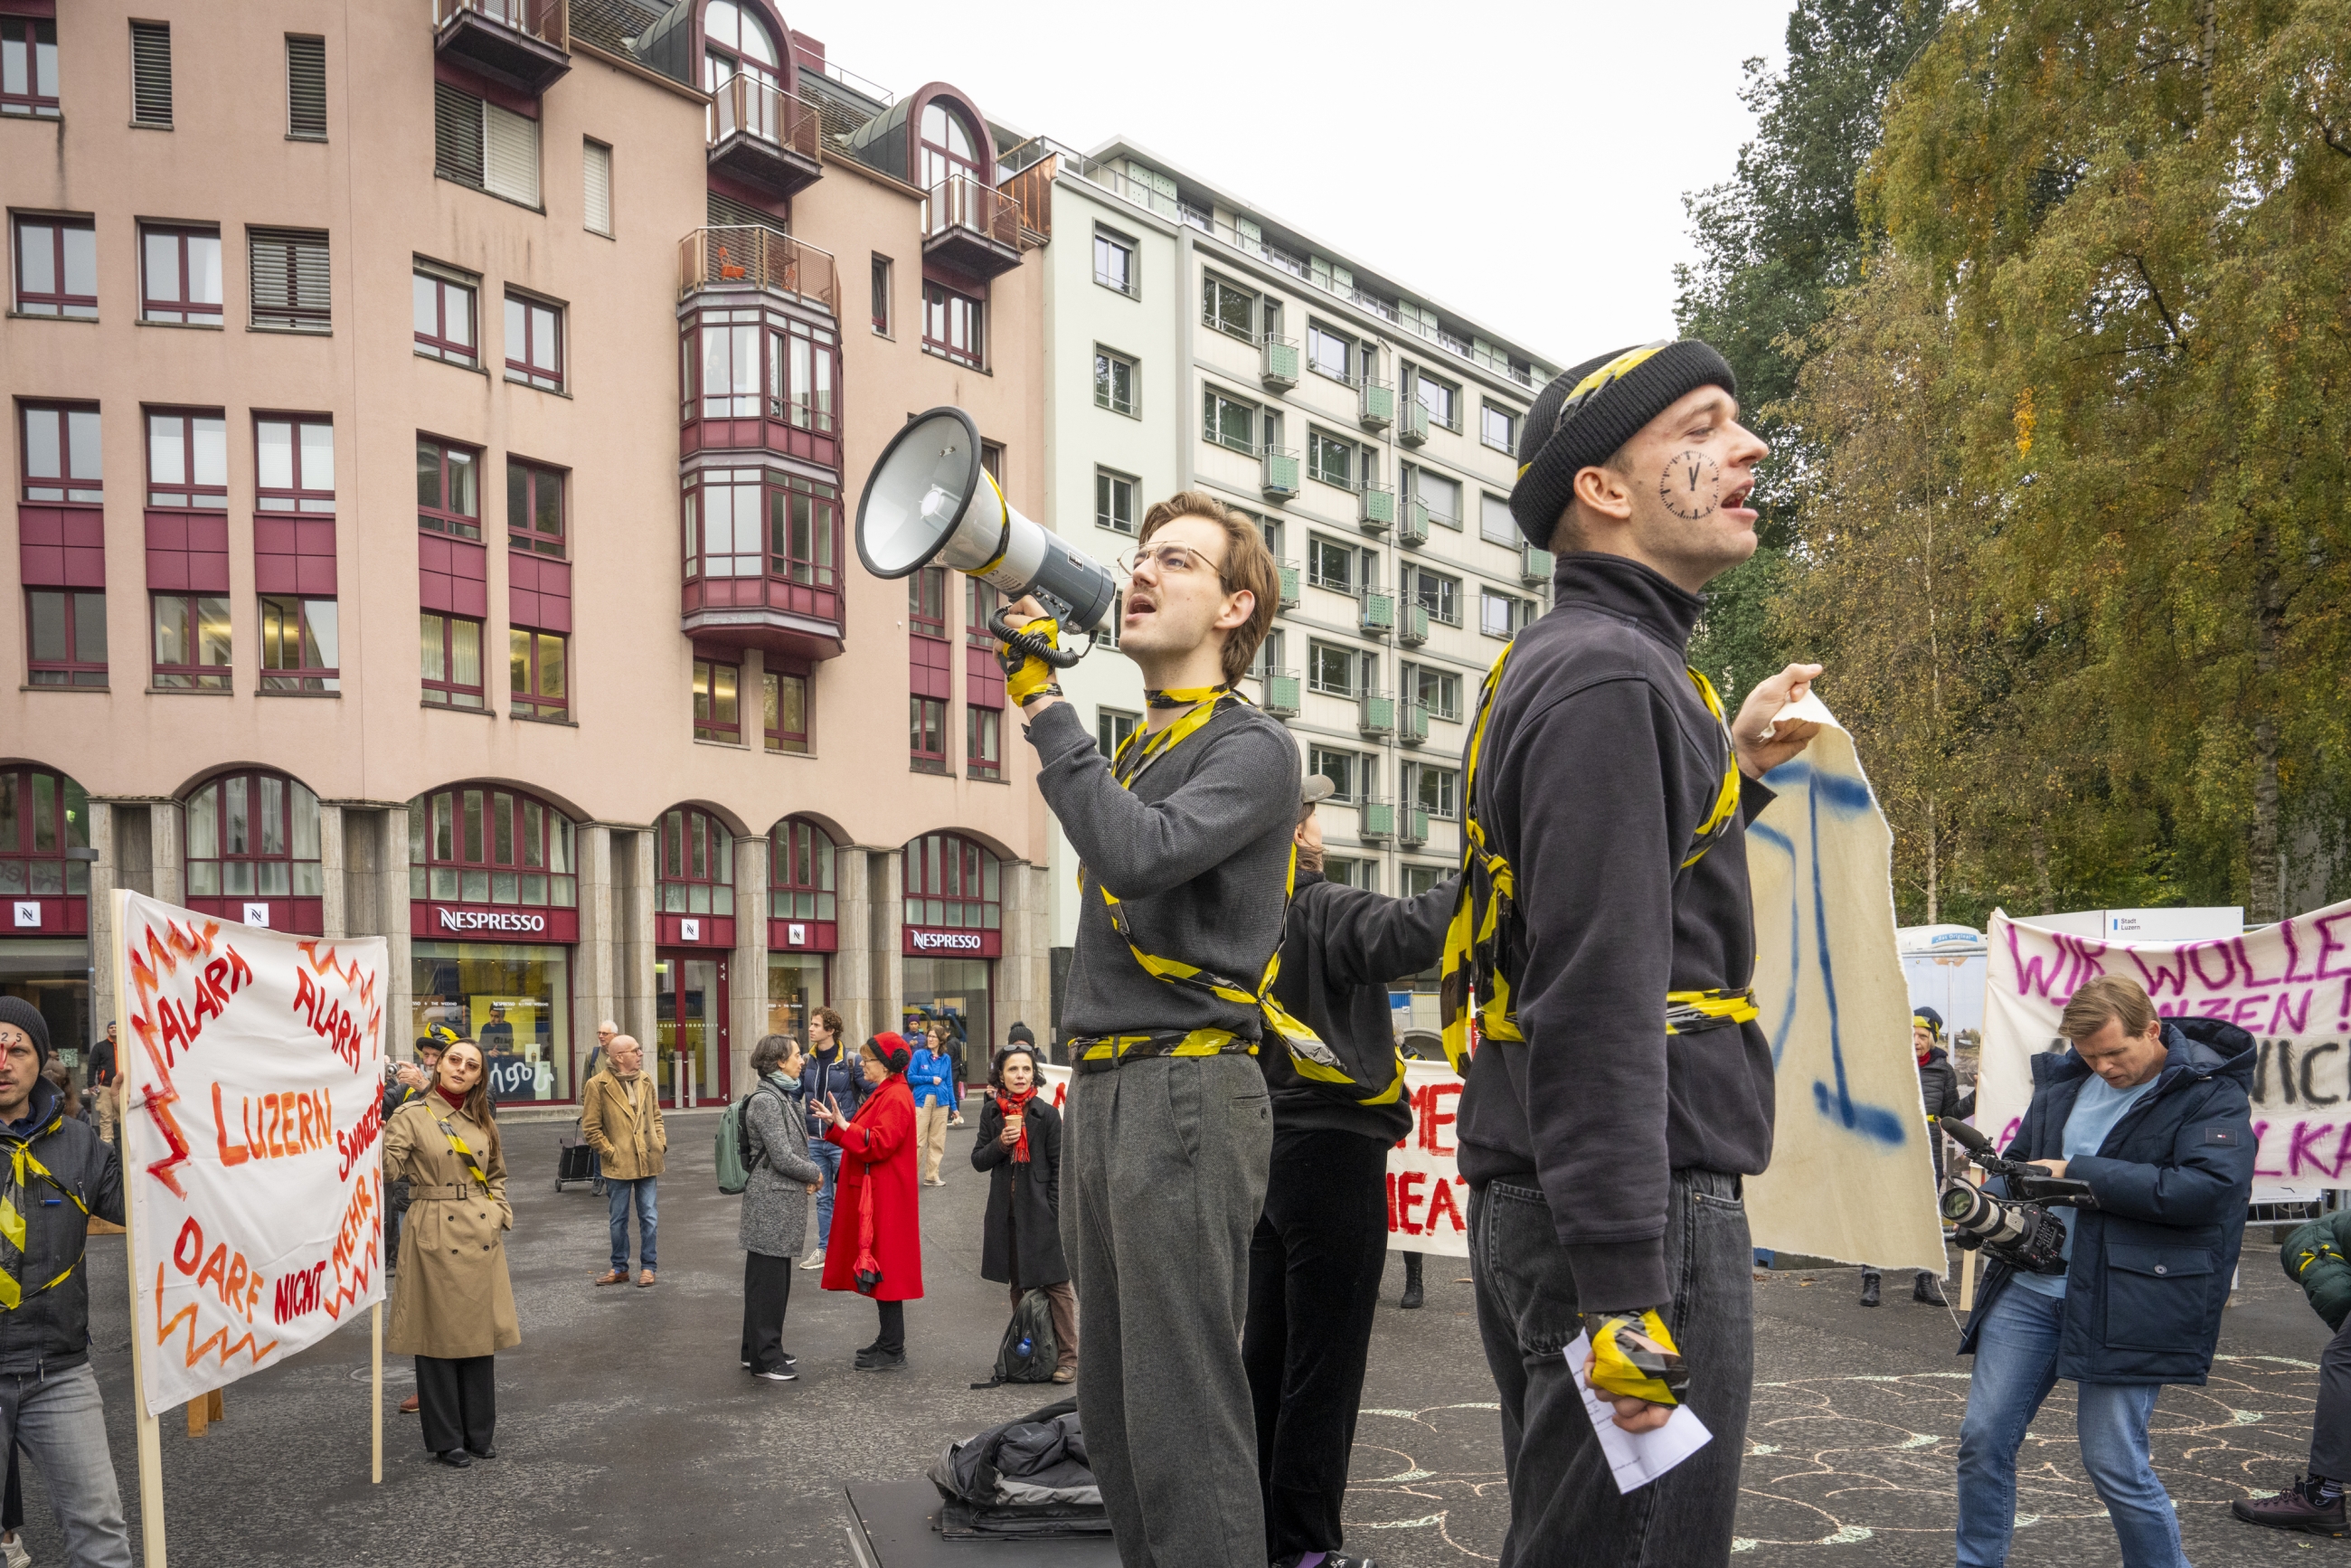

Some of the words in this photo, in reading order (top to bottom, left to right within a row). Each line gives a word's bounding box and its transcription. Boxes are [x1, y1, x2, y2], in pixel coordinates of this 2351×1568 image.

[436, 907, 544, 931] NESPRESSO
[911, 930, 981, 949] NESPRESSO
[157, 944, 252, 1069] ALARM
[293, 966, 362, 1074] ALARM
[212, 1082, 333, 1167] LUZERN
[174, 1215, 264, 1325] DARF
[274, 1260, 326, 1326] NICHT
[332, 1174, 373, 1284] MEHR
